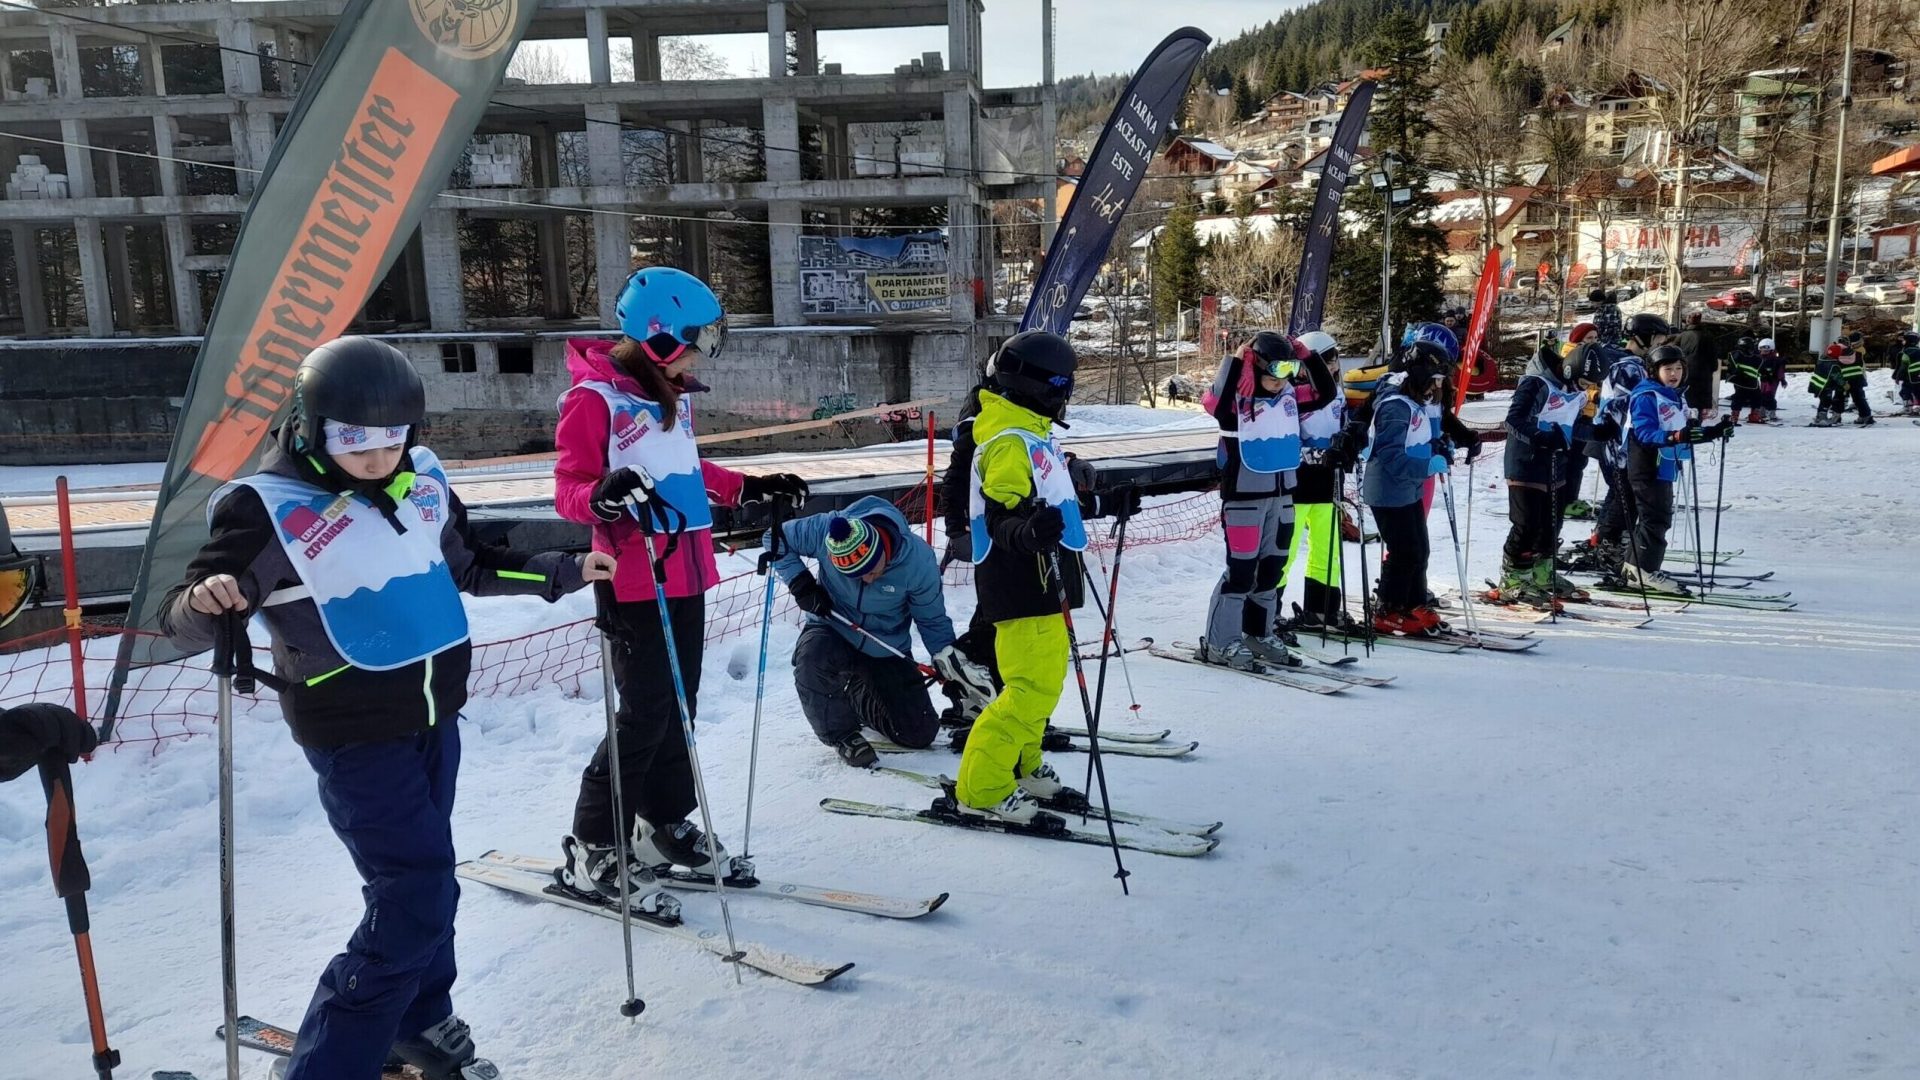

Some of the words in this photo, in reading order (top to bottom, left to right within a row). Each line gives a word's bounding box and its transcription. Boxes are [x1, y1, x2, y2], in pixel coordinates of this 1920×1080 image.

[1130, 93, 1158, 135] IARNA
[1114, 117, 1153, 164] ACEASTA
[1111, 151, 1134, 181] ESTE
[1091, 182, 1125, 224] Hot
[875, 276, 946, 288] APARTAMENTE
[881, 289, 896, 298] DE
[899, 286, 947, 298] VÂNZARE
[304, 514, 354, 560] EXPERIENCE
